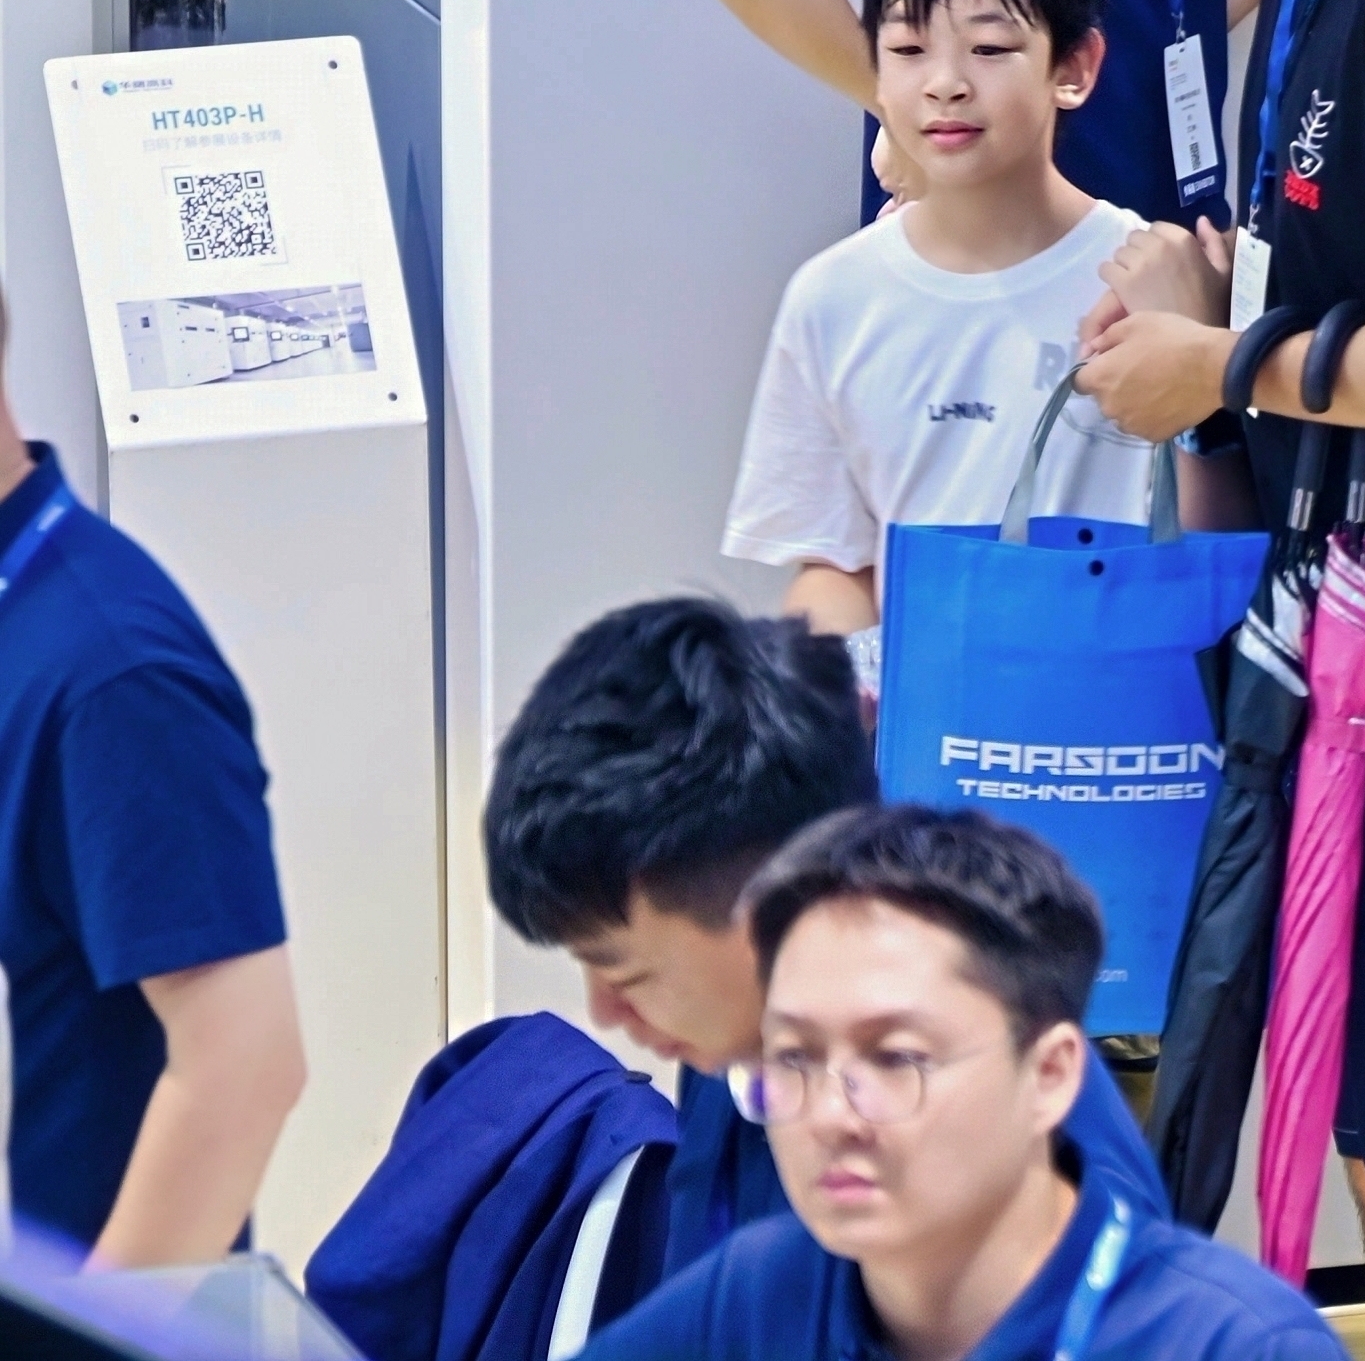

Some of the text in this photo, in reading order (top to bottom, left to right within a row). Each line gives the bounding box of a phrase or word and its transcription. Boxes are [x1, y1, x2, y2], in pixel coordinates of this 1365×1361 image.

[151, 103, 265, 131] HT403P-H
[941, 736, 1226, 776] FARSOON
[956, 779, 1206, 802] TECHNOLOGIES
